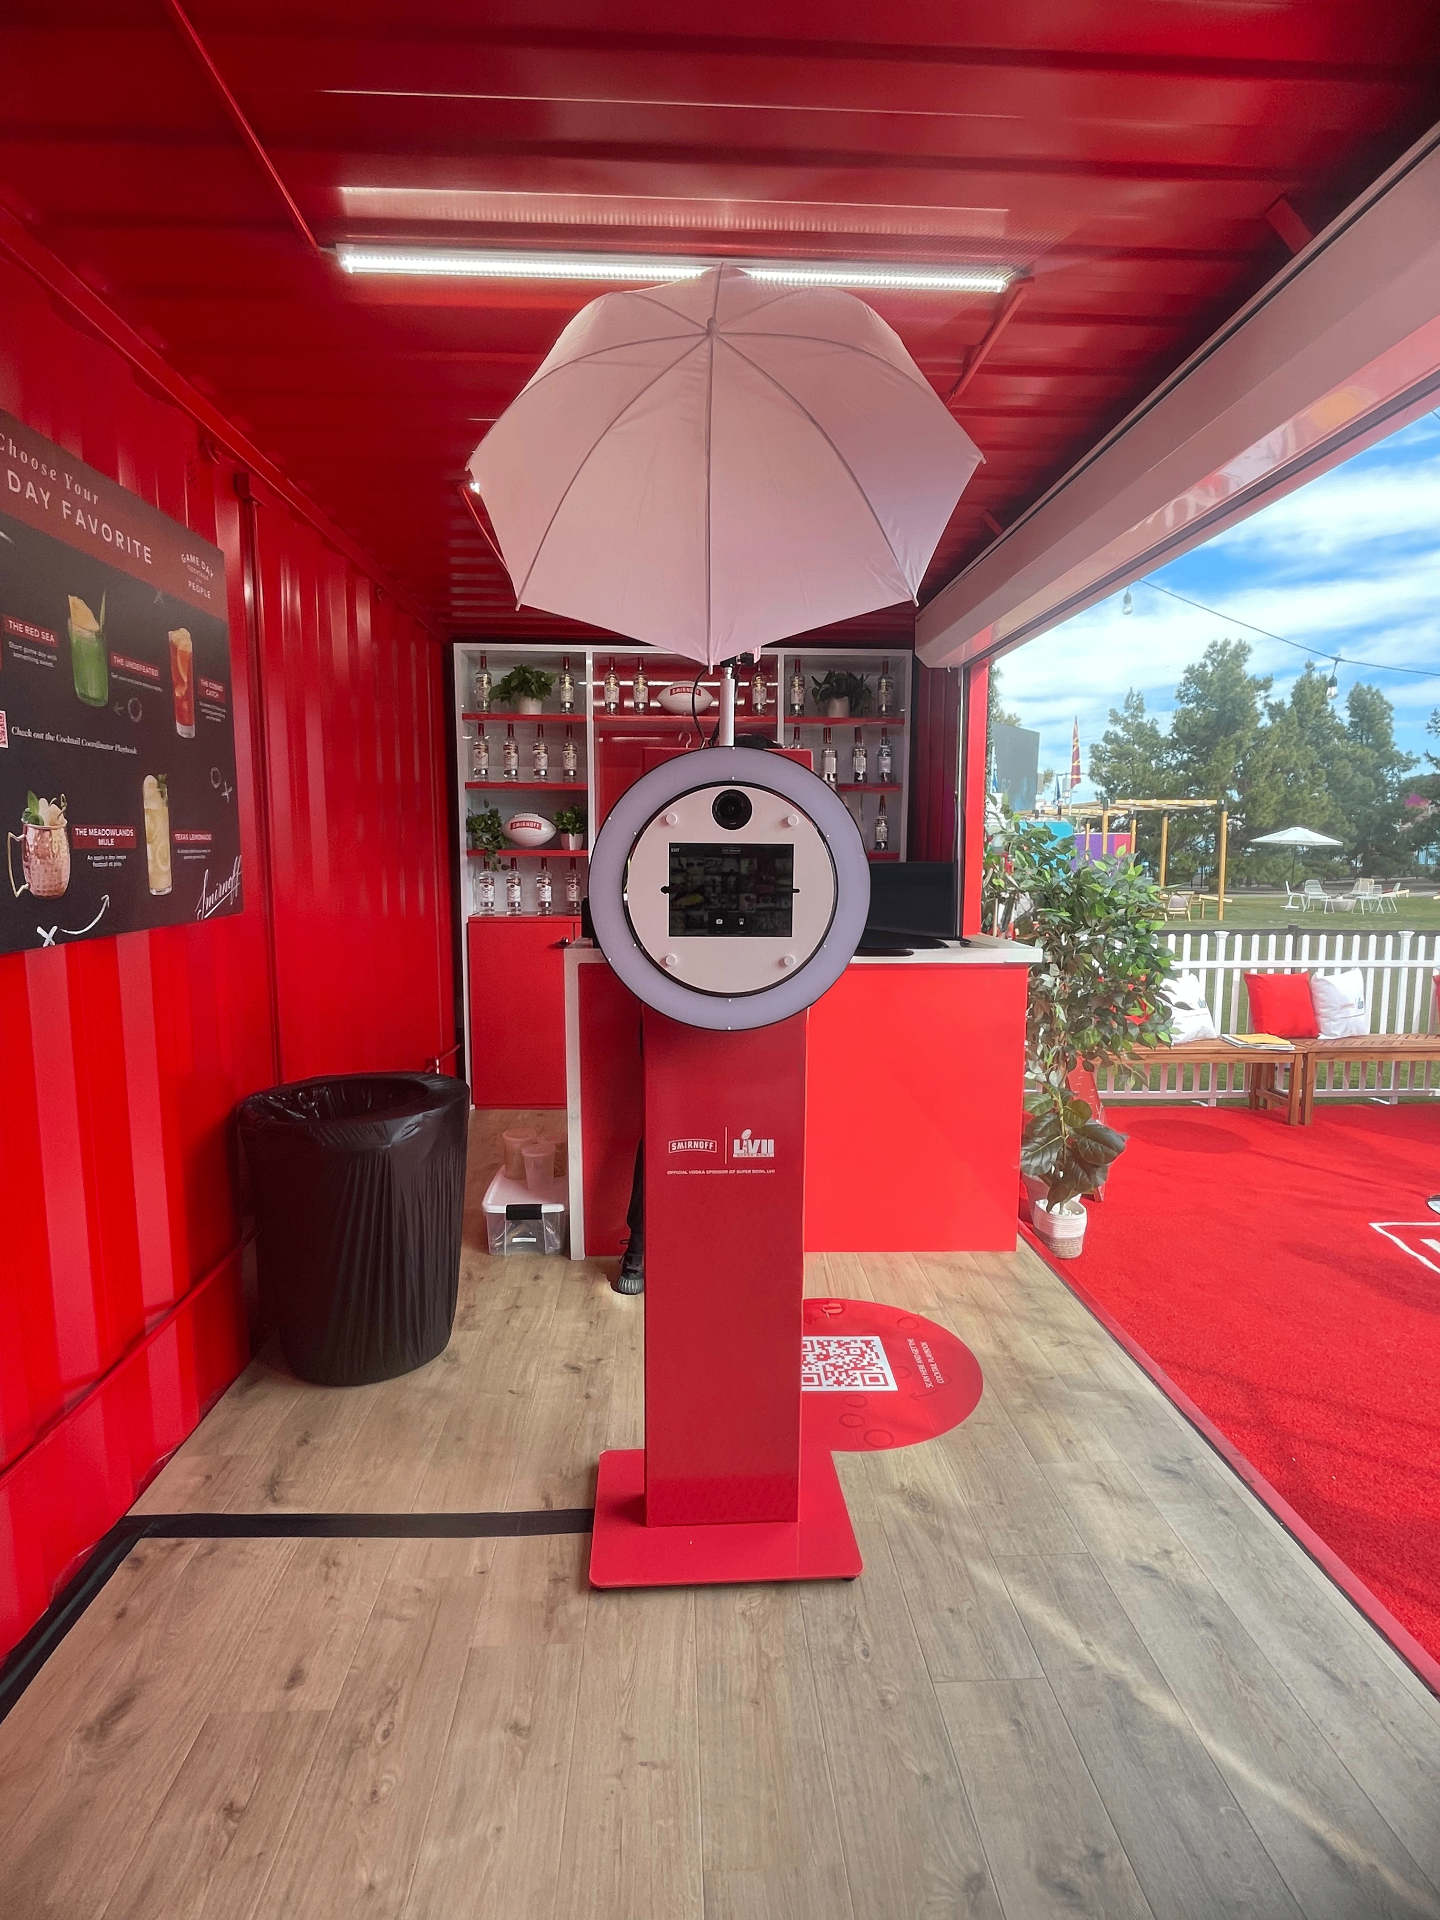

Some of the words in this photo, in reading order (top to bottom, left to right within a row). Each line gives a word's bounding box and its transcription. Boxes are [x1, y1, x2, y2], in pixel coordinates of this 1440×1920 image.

[64, 472, 99, 505] Your
[7, 469, 51, 510] DAY
[62, 499, 153, 565] FAVORITE
[180, 553, 201, 566] GAME
[201, 560, 215, 579] DAY
[188, 579, 212, 600] PEOPLE
[8, 619, 24, 633] THE
[24, 625, 41, 638] RED
[40, 631, 55, 642] SEA
[113, 655, 125, 666] THE
[11, 726, 33, 738] Check
[33, 732, 44, 740] out
[45, 731, 55, 742] the
[75, 828, 88, 836] THE
[88, 828, 134, 837] MEADOWLANDS
[98, 838, 115, 846] MULE
[195, 855, 243, 921] Smirnoff
[671, 1141, 714, 1151] SMIRNOFF
[921, 1375, 934, 1388] SCAN
